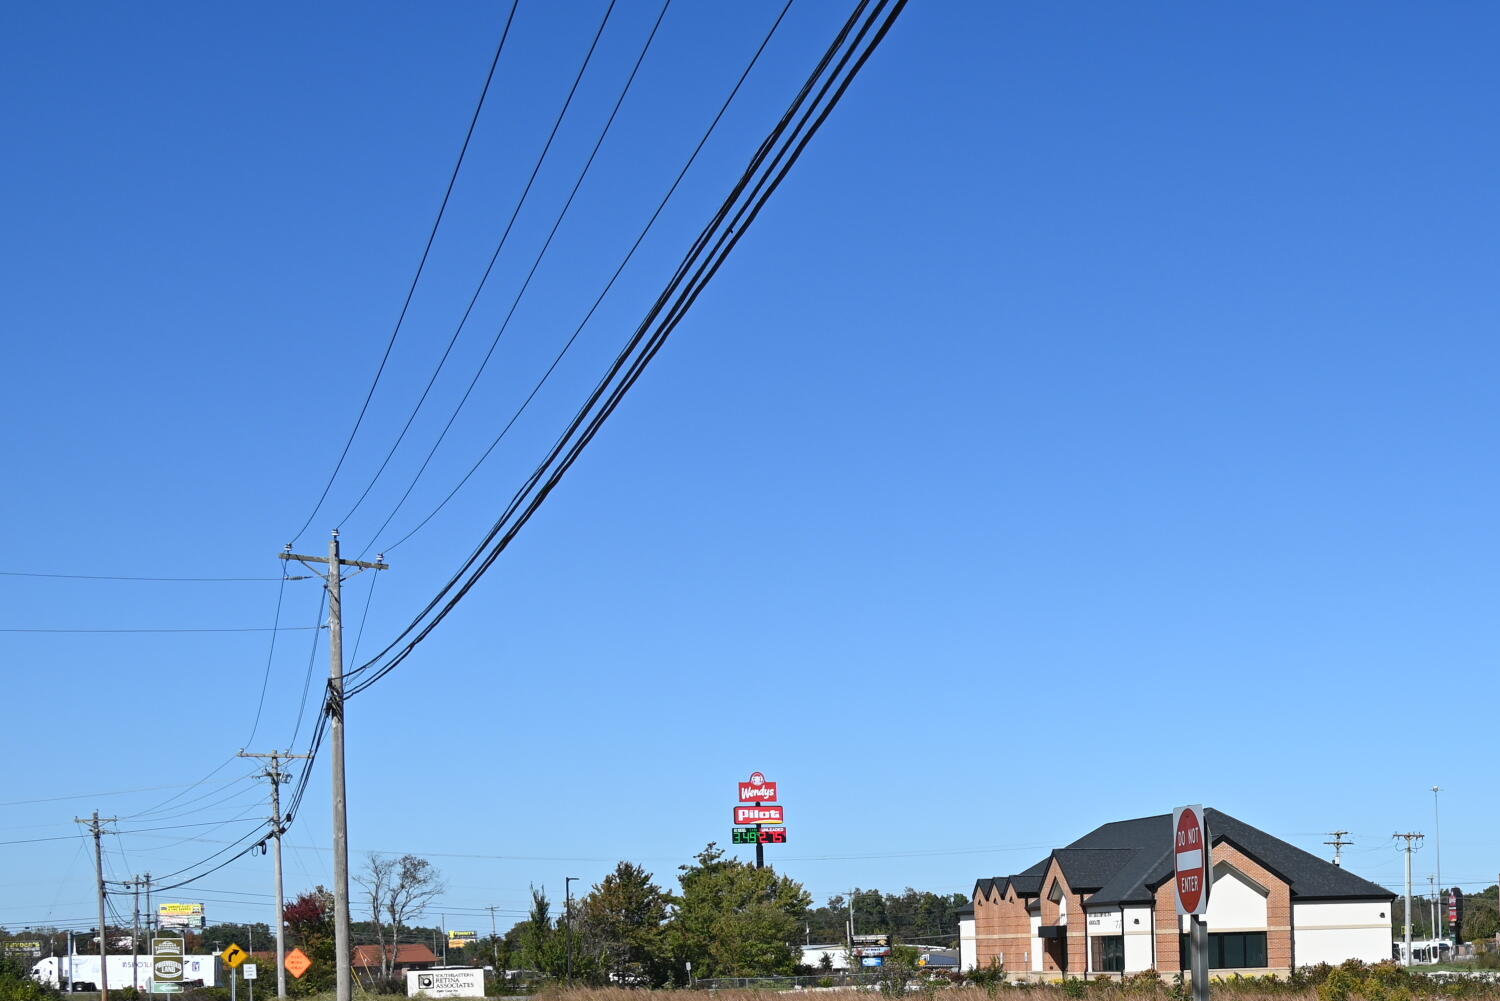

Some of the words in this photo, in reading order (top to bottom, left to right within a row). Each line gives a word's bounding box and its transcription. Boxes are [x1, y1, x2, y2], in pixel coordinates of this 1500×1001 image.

[738, 810, 780, 821] Pilot
[759, 831, 783, 843] 275
[1178, 831, 1186, 846] DO
[1188, 827, 1199, 844] NOT
[1182, 875, 1199, 893] ENTER
